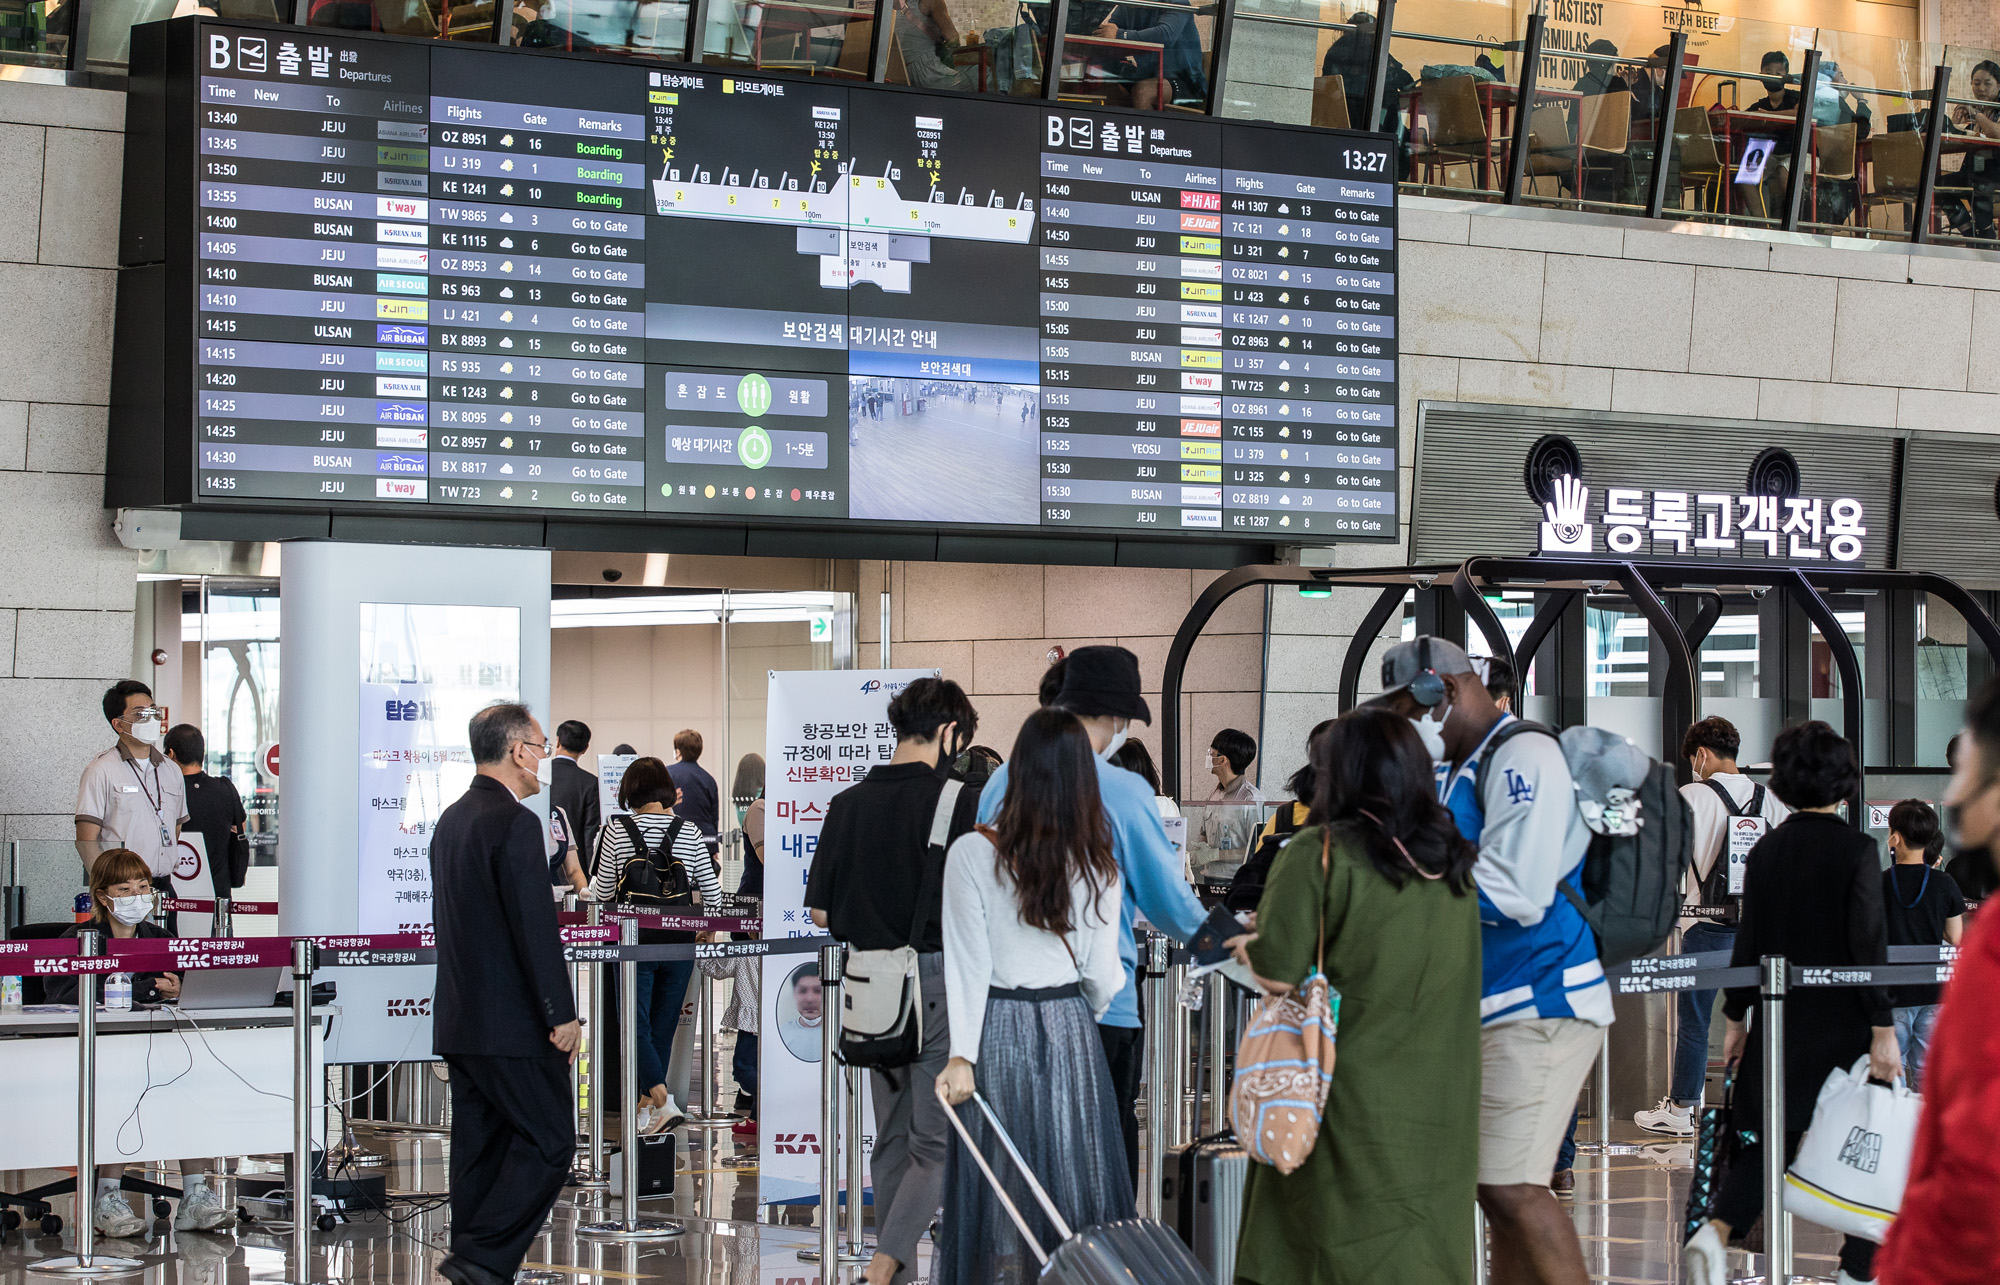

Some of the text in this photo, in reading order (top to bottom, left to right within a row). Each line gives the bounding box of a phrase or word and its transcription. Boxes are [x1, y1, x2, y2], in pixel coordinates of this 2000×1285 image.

[1553, 0, 1603, 26] TASTIEST
[1696, 16, 1719, 29] BEEF
[1543, 27, 1589, 52] RMULAS
[210, 35, 231, 69] B
[276, 42, 332, 77] 출발
[340, 51, 357, 63] 出發
[340, 68, 392, 82] Departures
[1539, 57, 1587, 81] ITH ONLY
[663, 74, 704, 88] 탑승게이트
[736, 81, 784, 96] 리모트게이트
[208, 85, 622, 132] Time New To Airlines Flights Gate Remarks
[654, 106, 673, 114] LJ319
[815, 121, 838, 130] KE1241
[1048, 116, 1064, 146] B
[207, 111, 623, 159] 13:40 JEJU OZ 8951 16 Boarding
[818, 131, 835, 139] 13:50
[917, 131, 941, 139] OZ8951
[1100, 122, 1144, 153] 출발
[1150, 129, 1165, 140] 出發
[921, 141, 938, 149] 13:40
[1150, 145, 1192, 157] Departures
[1343, 150, 1387, 172] 13:27
[1047, 160, 1375, 199] Time New To Airlines Flights Gate Remarks
[1046, 184, 1379, 221] 14:40 ULSAN Hi Air 4H 1307 13 Go to Gate
[207, 190, 237, 202] 13:55
[314, 198, 352, 211] BUSAN
[440, 208, 459, 219] TW
[461, 209, 487, 222] 9865
[532, 215, 538, 225] 3
[572, 218, 586, 230] Go
[590, 219, 600, 230] to
[604, 221, 628, 232] Gate
[850, 241, 878, 251] 보안검색
[207, 319, 541, 350] 14:15 ULSAN AIR BUSAN BX 8893 15
[783, 321, 938, 350] 보안검색 대기시간 안내
[920, 361, 971, 376] 보안검색대
[789, 390, 810, 404] 원활
[671, 437, 732, 454] 예상 대기시간
[785, 442, 814, 457] 1~5분
[1047, 440, 1264, 460] 15:25 YEOSU LJ 379
[1603, 489, 1866, 561] 등록고객전용
[803, 724, 867, 740] 항공보안
[373, 750, 400, 761] 마스크
[404, 750, 429, 763] 착용이
[434, 750, 447, 762] 5월
[783, 744, 897, 761] 규정에 따라 탑
[786, 766, 867, 783] 신분확인을
[1504, 769, 1533, 804] LA
[777, 800, 830, 824] 마스
[394, 847, 419, 859] 마스크
[387, 869, 426, 881] 약국(3층),
[662, 917, 680, 927] KAC
[571, 929, 610, 938] 한국공항공사
[168, 940, 244, 952] KAC 한국공항공사
[329, 938, 370, 947] 한국공항공사
[338, 951, 416, 964] KAC 한국공항공사
[576, 950, 619, 959] 한국공항공사
[695, 944, 769, 958] KAC 한국공항공사
[34, 959, 119, 973] KAC 한국공항공사
[177, 954, 259, 968] KAC 한국공항공사
[1632, 958, 1658, 973] KAC
[1620, 976, 1651, 992] KAC
[1803, 969, 1831, 984] KAC
[387, 1000, 430, 1016] KAC
[774, 1134, 840, 1154] KA
